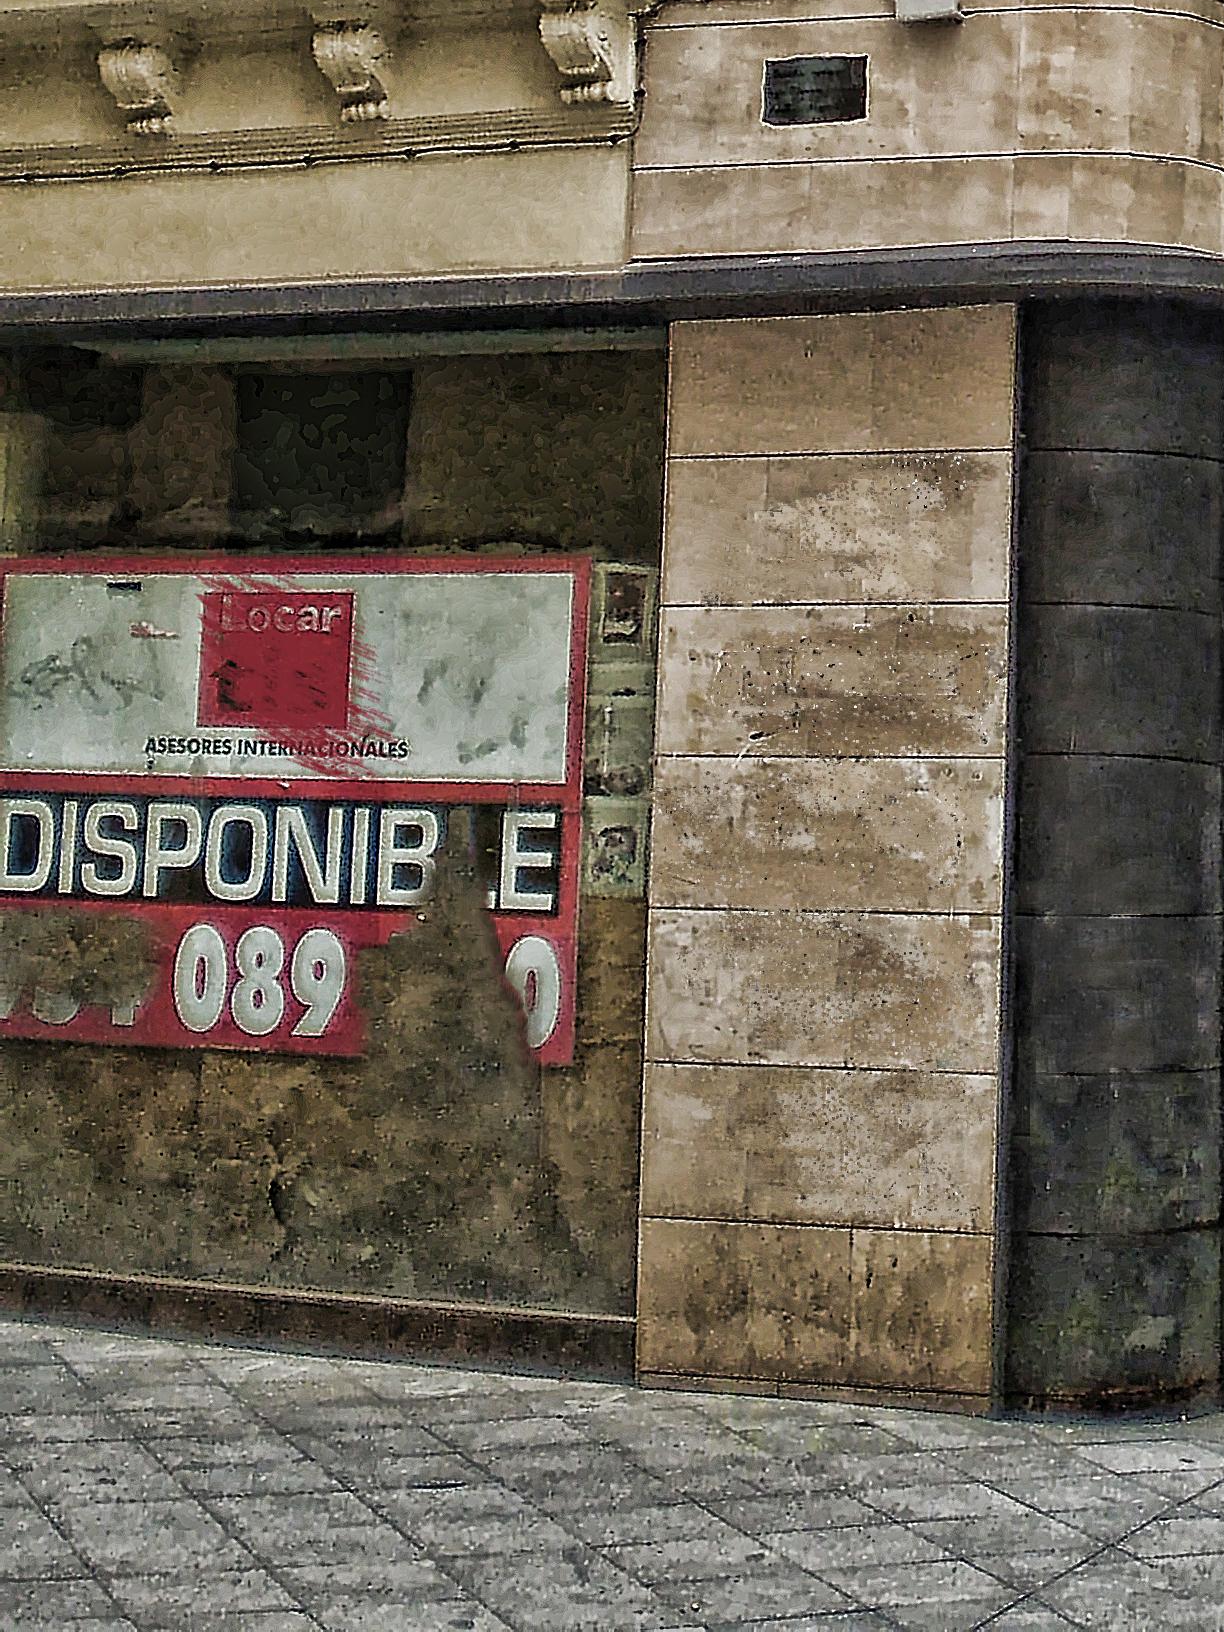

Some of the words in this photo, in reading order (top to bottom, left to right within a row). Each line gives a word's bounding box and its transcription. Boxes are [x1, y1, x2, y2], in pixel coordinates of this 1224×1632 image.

[221, 592, 343, 634] Locar
[145, 736, 232, 756] ASESORES
[237, 737, 409, 759] INTERNACIONALES
[0, 799, 556, 911] DISPONIBE
[173, 923, 346, 1036] 089
